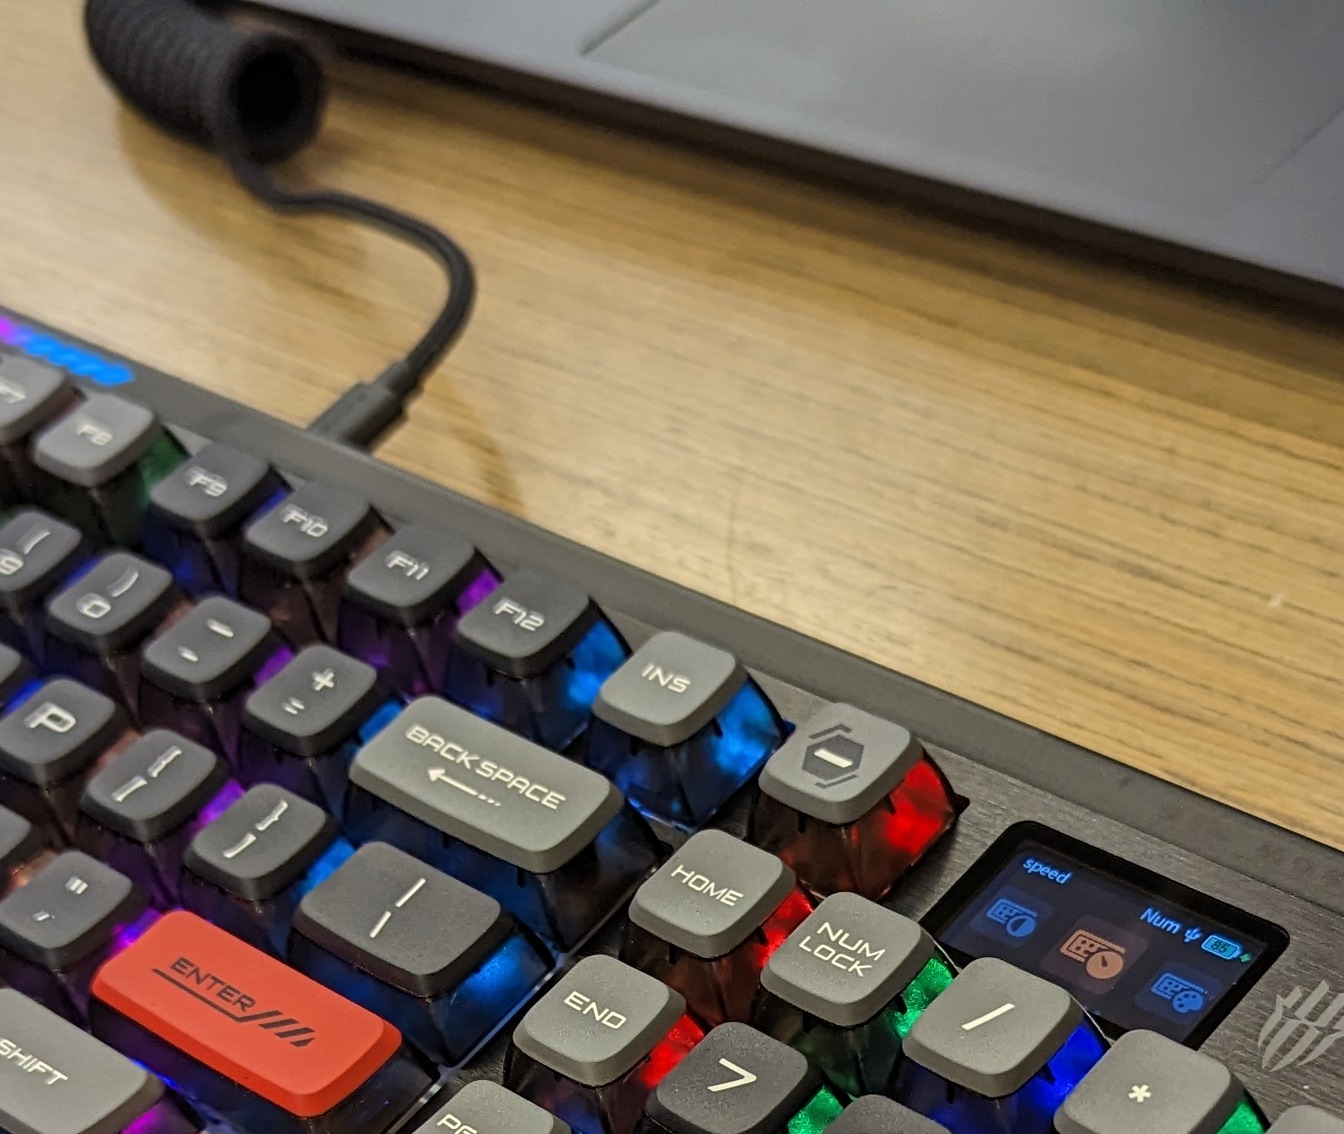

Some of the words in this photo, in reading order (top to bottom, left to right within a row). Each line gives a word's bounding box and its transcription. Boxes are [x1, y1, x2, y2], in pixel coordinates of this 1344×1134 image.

[186, 466, 229, 497] F9
[280, 503, 329, 538] F10
[386, 550, 430, 580] F11
[493, 599, 546, 632] F12
[641, 664, 692, 694] INS
[25, 703, 77, 734] P
[404, 724, 567, 813] BACKSPACE
[670, 863, 745, 908] HOME
[1022, 856, 1073, 886] speed
[1139, 905, 1183, 937] Num
[816, 920, 888, 963] NUM
[797, 940, 875, 979] LOCK
[170, 957, 258, 1013] ENTER
[563, 989, 629, 1031] END
[707, 1057, 759, 1094] 7
